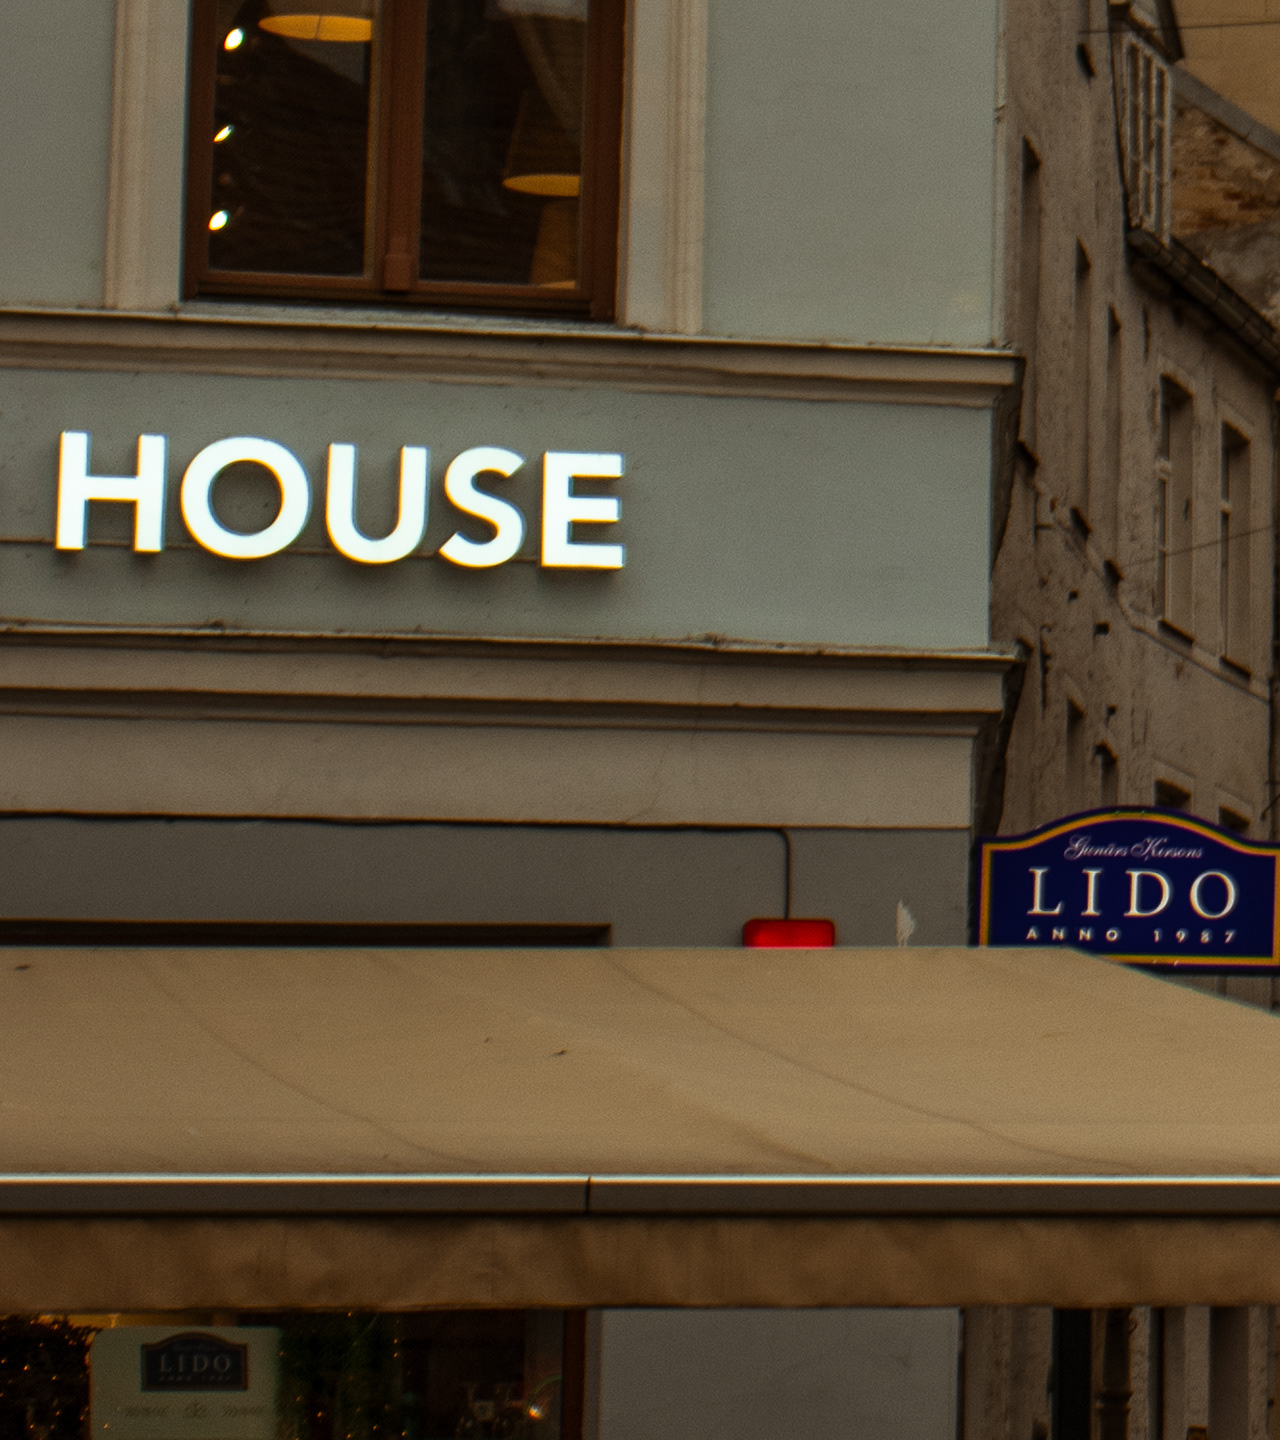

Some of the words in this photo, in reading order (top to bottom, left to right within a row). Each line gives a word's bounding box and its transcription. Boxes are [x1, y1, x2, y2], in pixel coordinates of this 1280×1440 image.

[54, 430, 627, 570] HOUSE
[1063, 834, 1128, 861] Gunārs
[1130, 835, 1205, 862] Kirsons
[1026, 865, 1240, 920] LIDO
[1025, 925, 1124, 943] ANNO
[1152, 927, 1239, 945] 1987
[159, 1353, 232, 1373] LIDO
